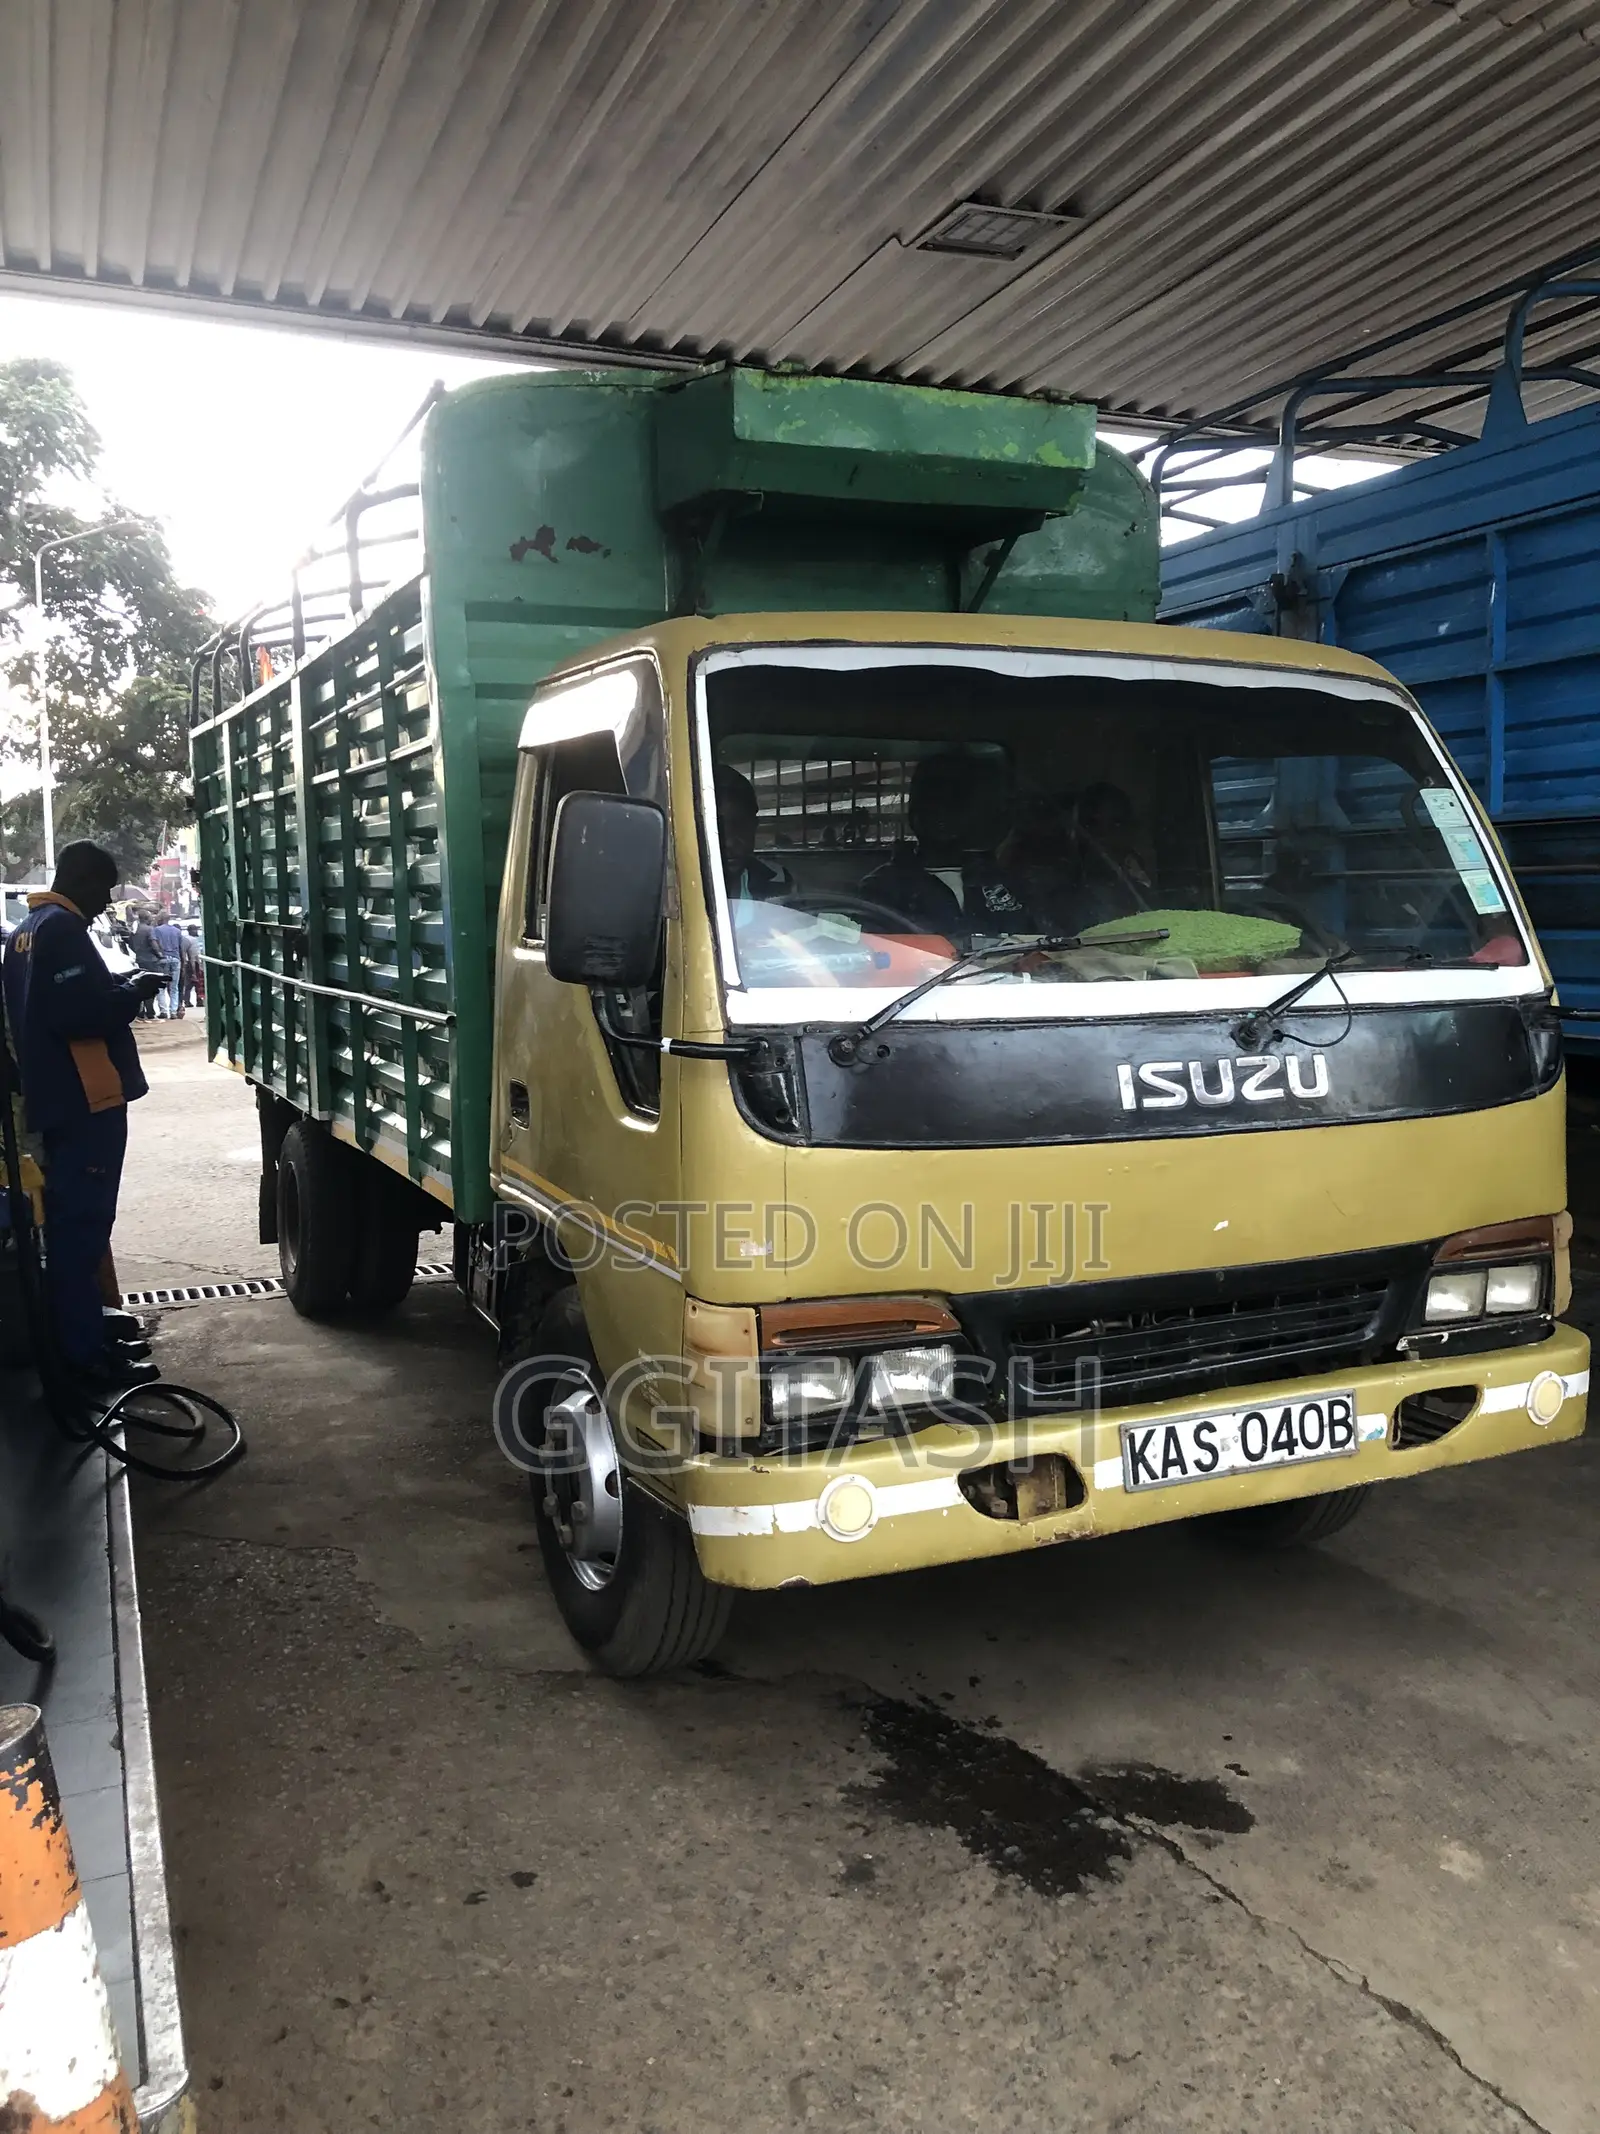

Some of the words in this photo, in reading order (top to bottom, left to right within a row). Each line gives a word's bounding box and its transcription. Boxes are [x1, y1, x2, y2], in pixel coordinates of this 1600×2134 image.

[1117, 1053, 1330, 1111] ISUZU
[1127, 1419, 1220, 1486] KAS
[1240, 1398, 1354, 1463] 040B
